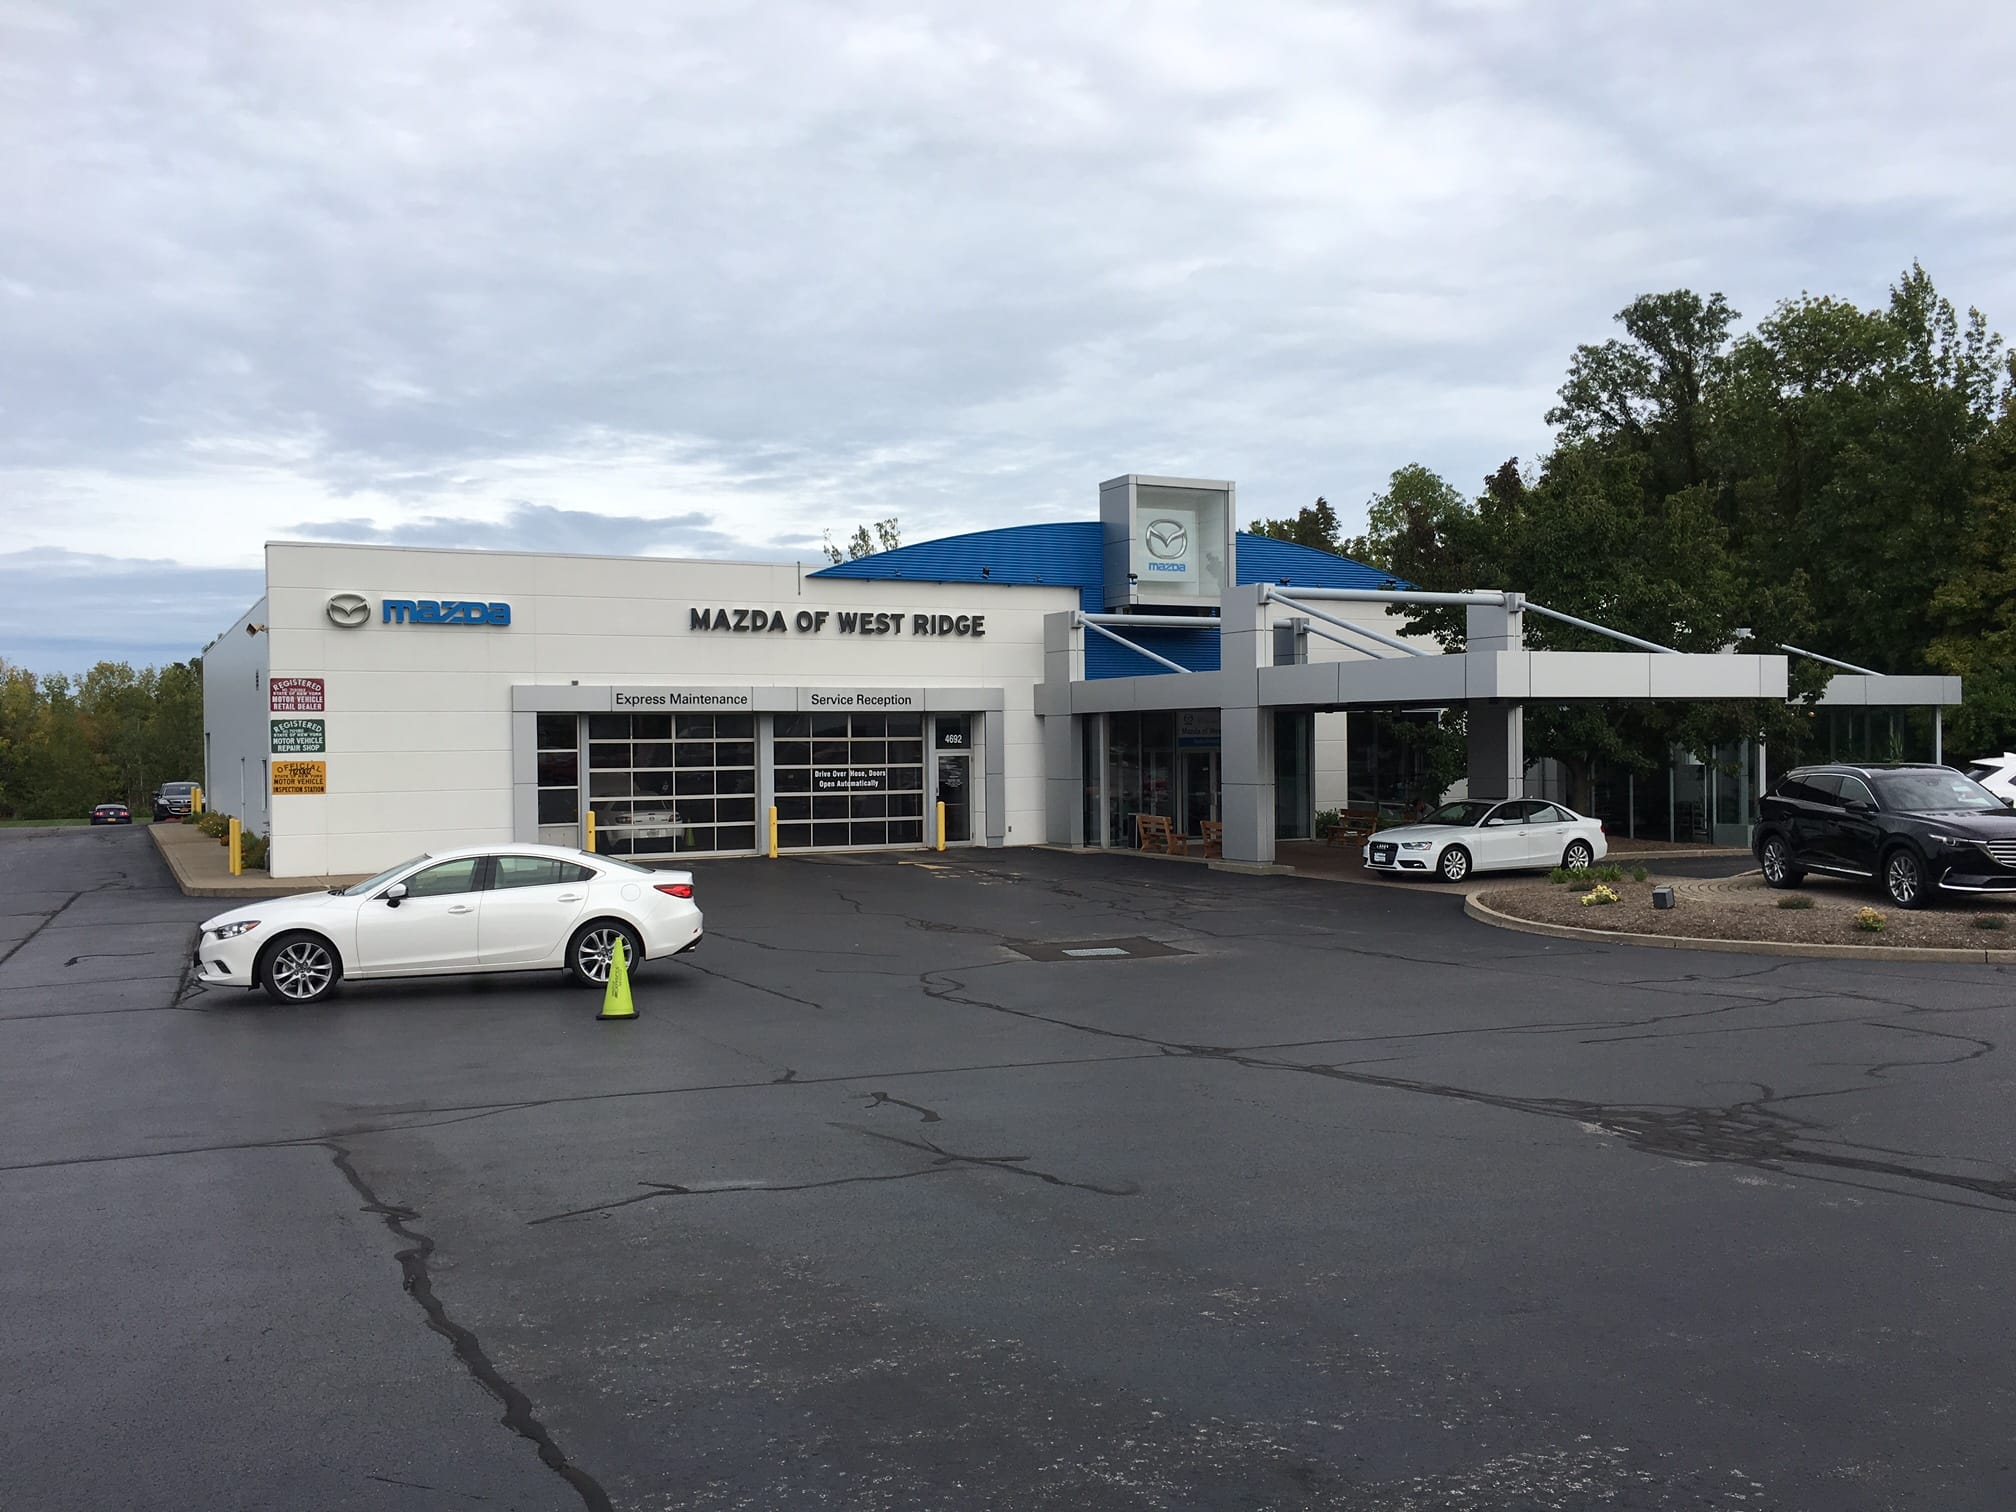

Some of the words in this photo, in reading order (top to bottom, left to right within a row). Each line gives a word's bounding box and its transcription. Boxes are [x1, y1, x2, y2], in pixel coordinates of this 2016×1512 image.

[1149, 562, 1186, 572] mazda
[382, 600, 511, 625] mazda
[690, 607, 788, 632] MAZDA
[796, 611, 829, 632] OF
[837, 612, 905, 634] WEST
[912, 613, 985, 636] RIDGE
[272, 679, 322, 692] REGISTERED
[296, 695, 324, 703] VEHICLE
[616, 693, 666, 707] Express
[669, 693, 748, 705] Maintenance
[811, 694, 853, 705] Service
[856, 694, 912, 707] Reception
[273, 703, 296, 711] RETAIL
[297, 703, 322, 711] DEALER
[272, 720, 322, 733] REGISTERED
[273, 737, 295, 745] MOTOR
[296, 736, 324, 745] VEHICLE
[944, 734, 963, 744] 4692
[277, 744, 301, 752] REPAIR
[302, 744, 320, 752] SHOP
[273, 778, 296, 786] MOTOR
[297, 778, 324, 786] VEHICLE
